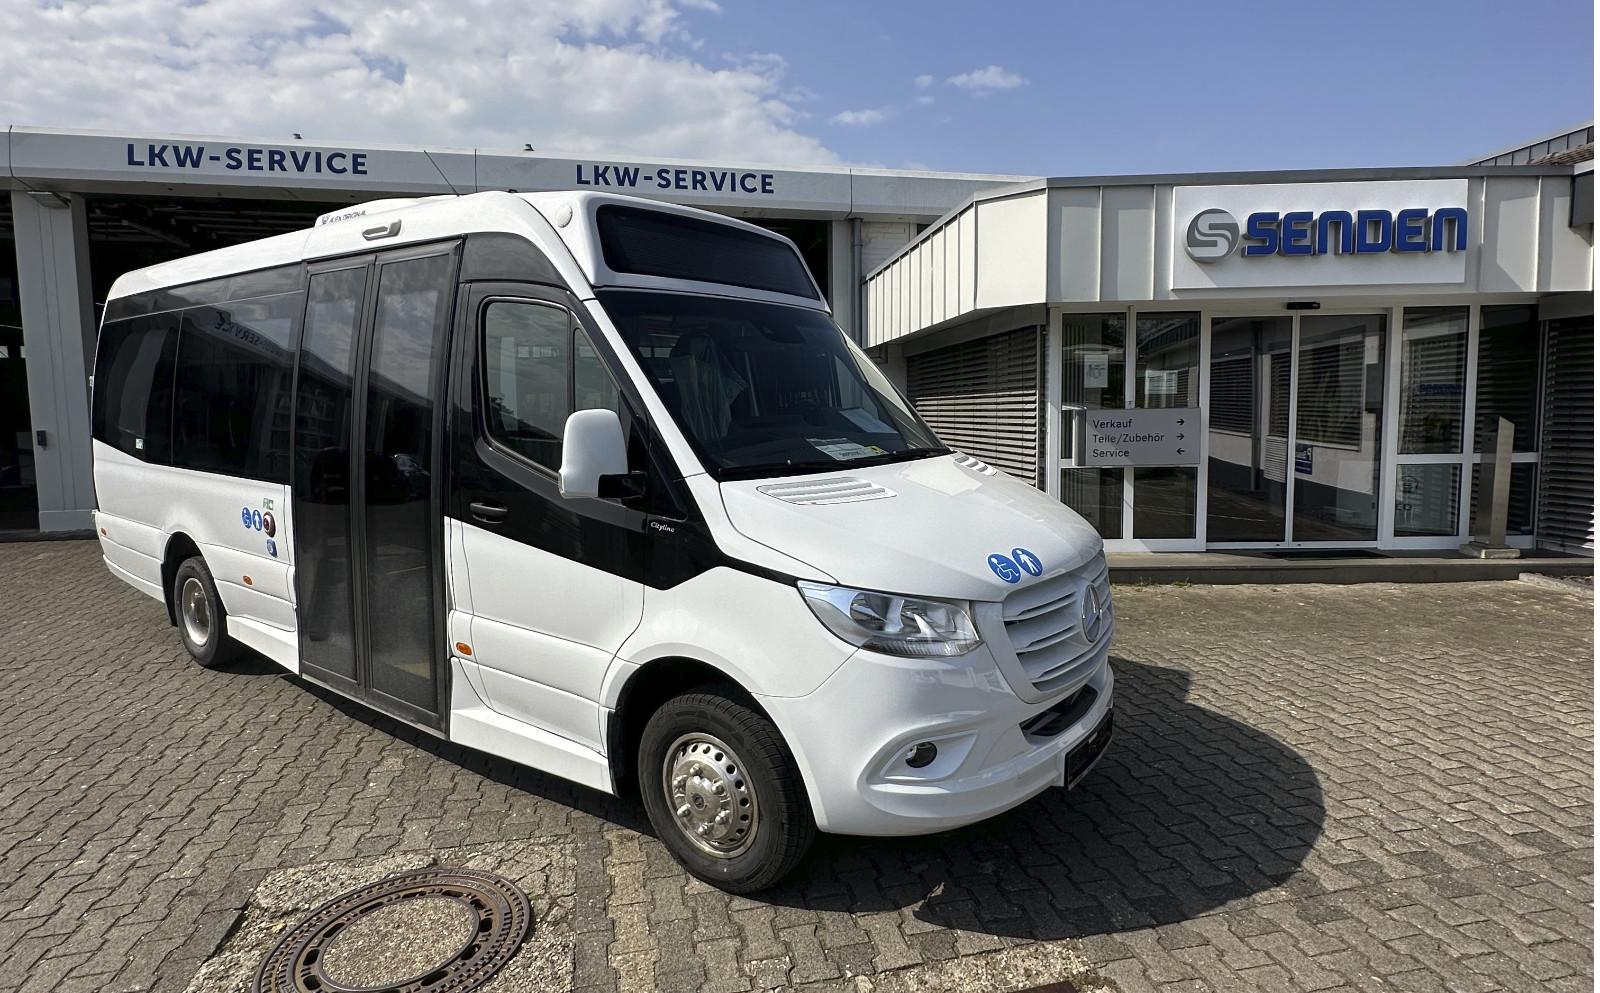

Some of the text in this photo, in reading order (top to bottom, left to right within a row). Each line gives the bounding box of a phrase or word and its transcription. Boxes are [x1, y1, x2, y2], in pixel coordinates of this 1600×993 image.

[127, 143, 368, 175] LKW-SERVICE
[576, 164, 775, 194] LKW-SERVICE
[1244, 207, 1468, 257] SENDEN
[1092, 418, 1133, 429] Verkauf
[1092, 432, 1165, 445] Teile/Zubehör
[1092, 448, 1130, 458] Service
[650, 521, 675, 532] Cityline
